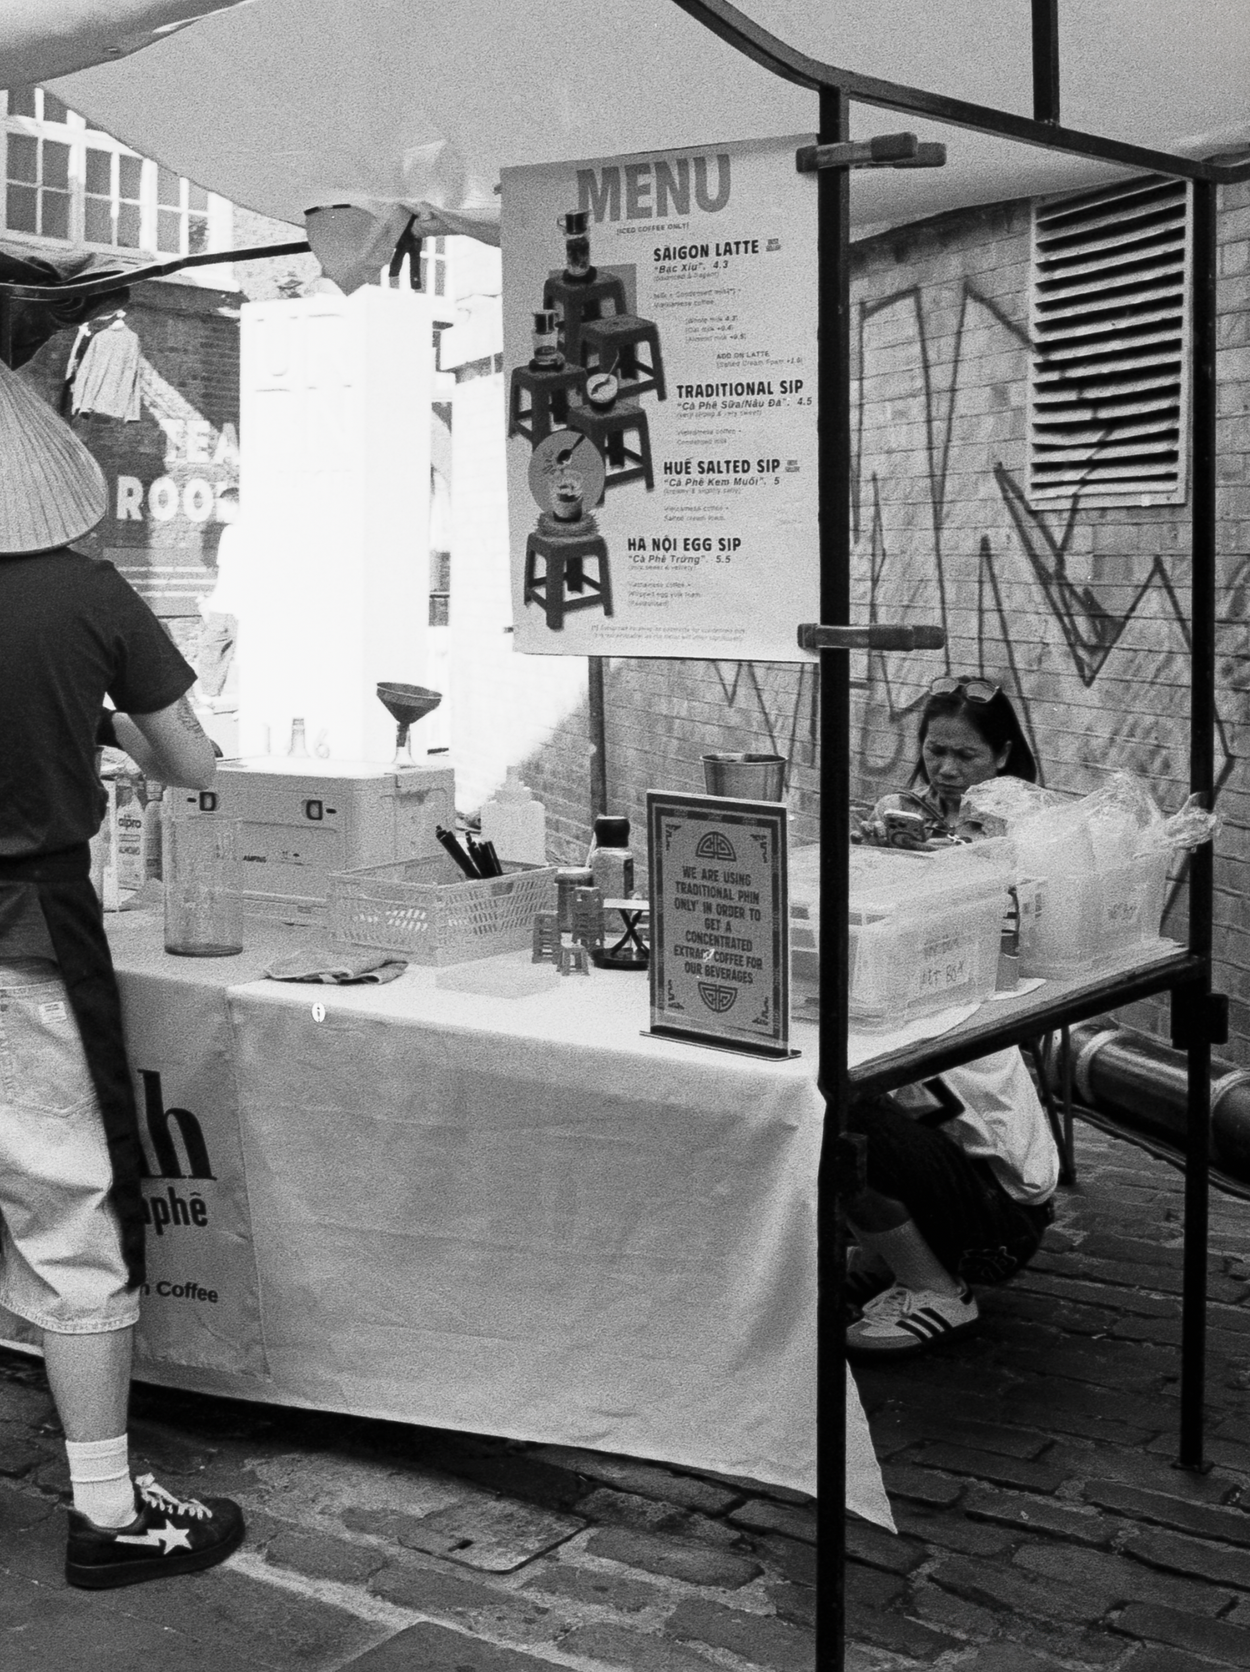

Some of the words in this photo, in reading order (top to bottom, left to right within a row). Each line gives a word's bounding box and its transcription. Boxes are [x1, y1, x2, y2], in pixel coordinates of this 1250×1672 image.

[576, 154, 731, 223] MENU
[653, 244, 709, 262] SAIGON
[715, 239, 759, 257] LATTE
[713, 260, 729, 269] 4.3
[746, 350, 770, 358] LATTE
[676, 381, 774, 399] TRADITIONAL
[780, 379, 804, 394] SIP
[699, 400, 718, 410] Phê
[797, 396, 813, 406] 4.5
[663, 457, 692, 475] HUẾ
[697, 459, 751, 475] SALTED
[756, 458, 780, 473] SIP
[685, 478, 704, 487] Phê
[708, 478, 730, 486] Kem
[774, 476, 780, 486] 5
[652, 534, 677, 554] NỘI
[683, 538, 712, 552] EGG
[718, 537, 742, 551] SIP
[649, 554, 666, 564] Phê
[716, 555, 731, 564] 5.5
[702, 868, 719, 882] ARE
[724, 872, 752, 886] USING
[675, 880, 735, 901] TRADITIONAL
[738, 890, 760, 905] PHIN
[702, 901, 712, 914] IN
[716, 903, 746, 918] ORDER
[749, 908, 761, 921] TO
[704, 918, 721, 931] GET
[725, 920, 732, 933] A
[685, 930, 753, 952] CONCENTRATED
[714, 951, 744, 967] COFFEE
[746, 956, 763, 970] FOR
[684, 962, 703, 976] OUR
[704, 964, 754, 984] BEVERAGES
[156, 1280, 219, 1304] Coffee
